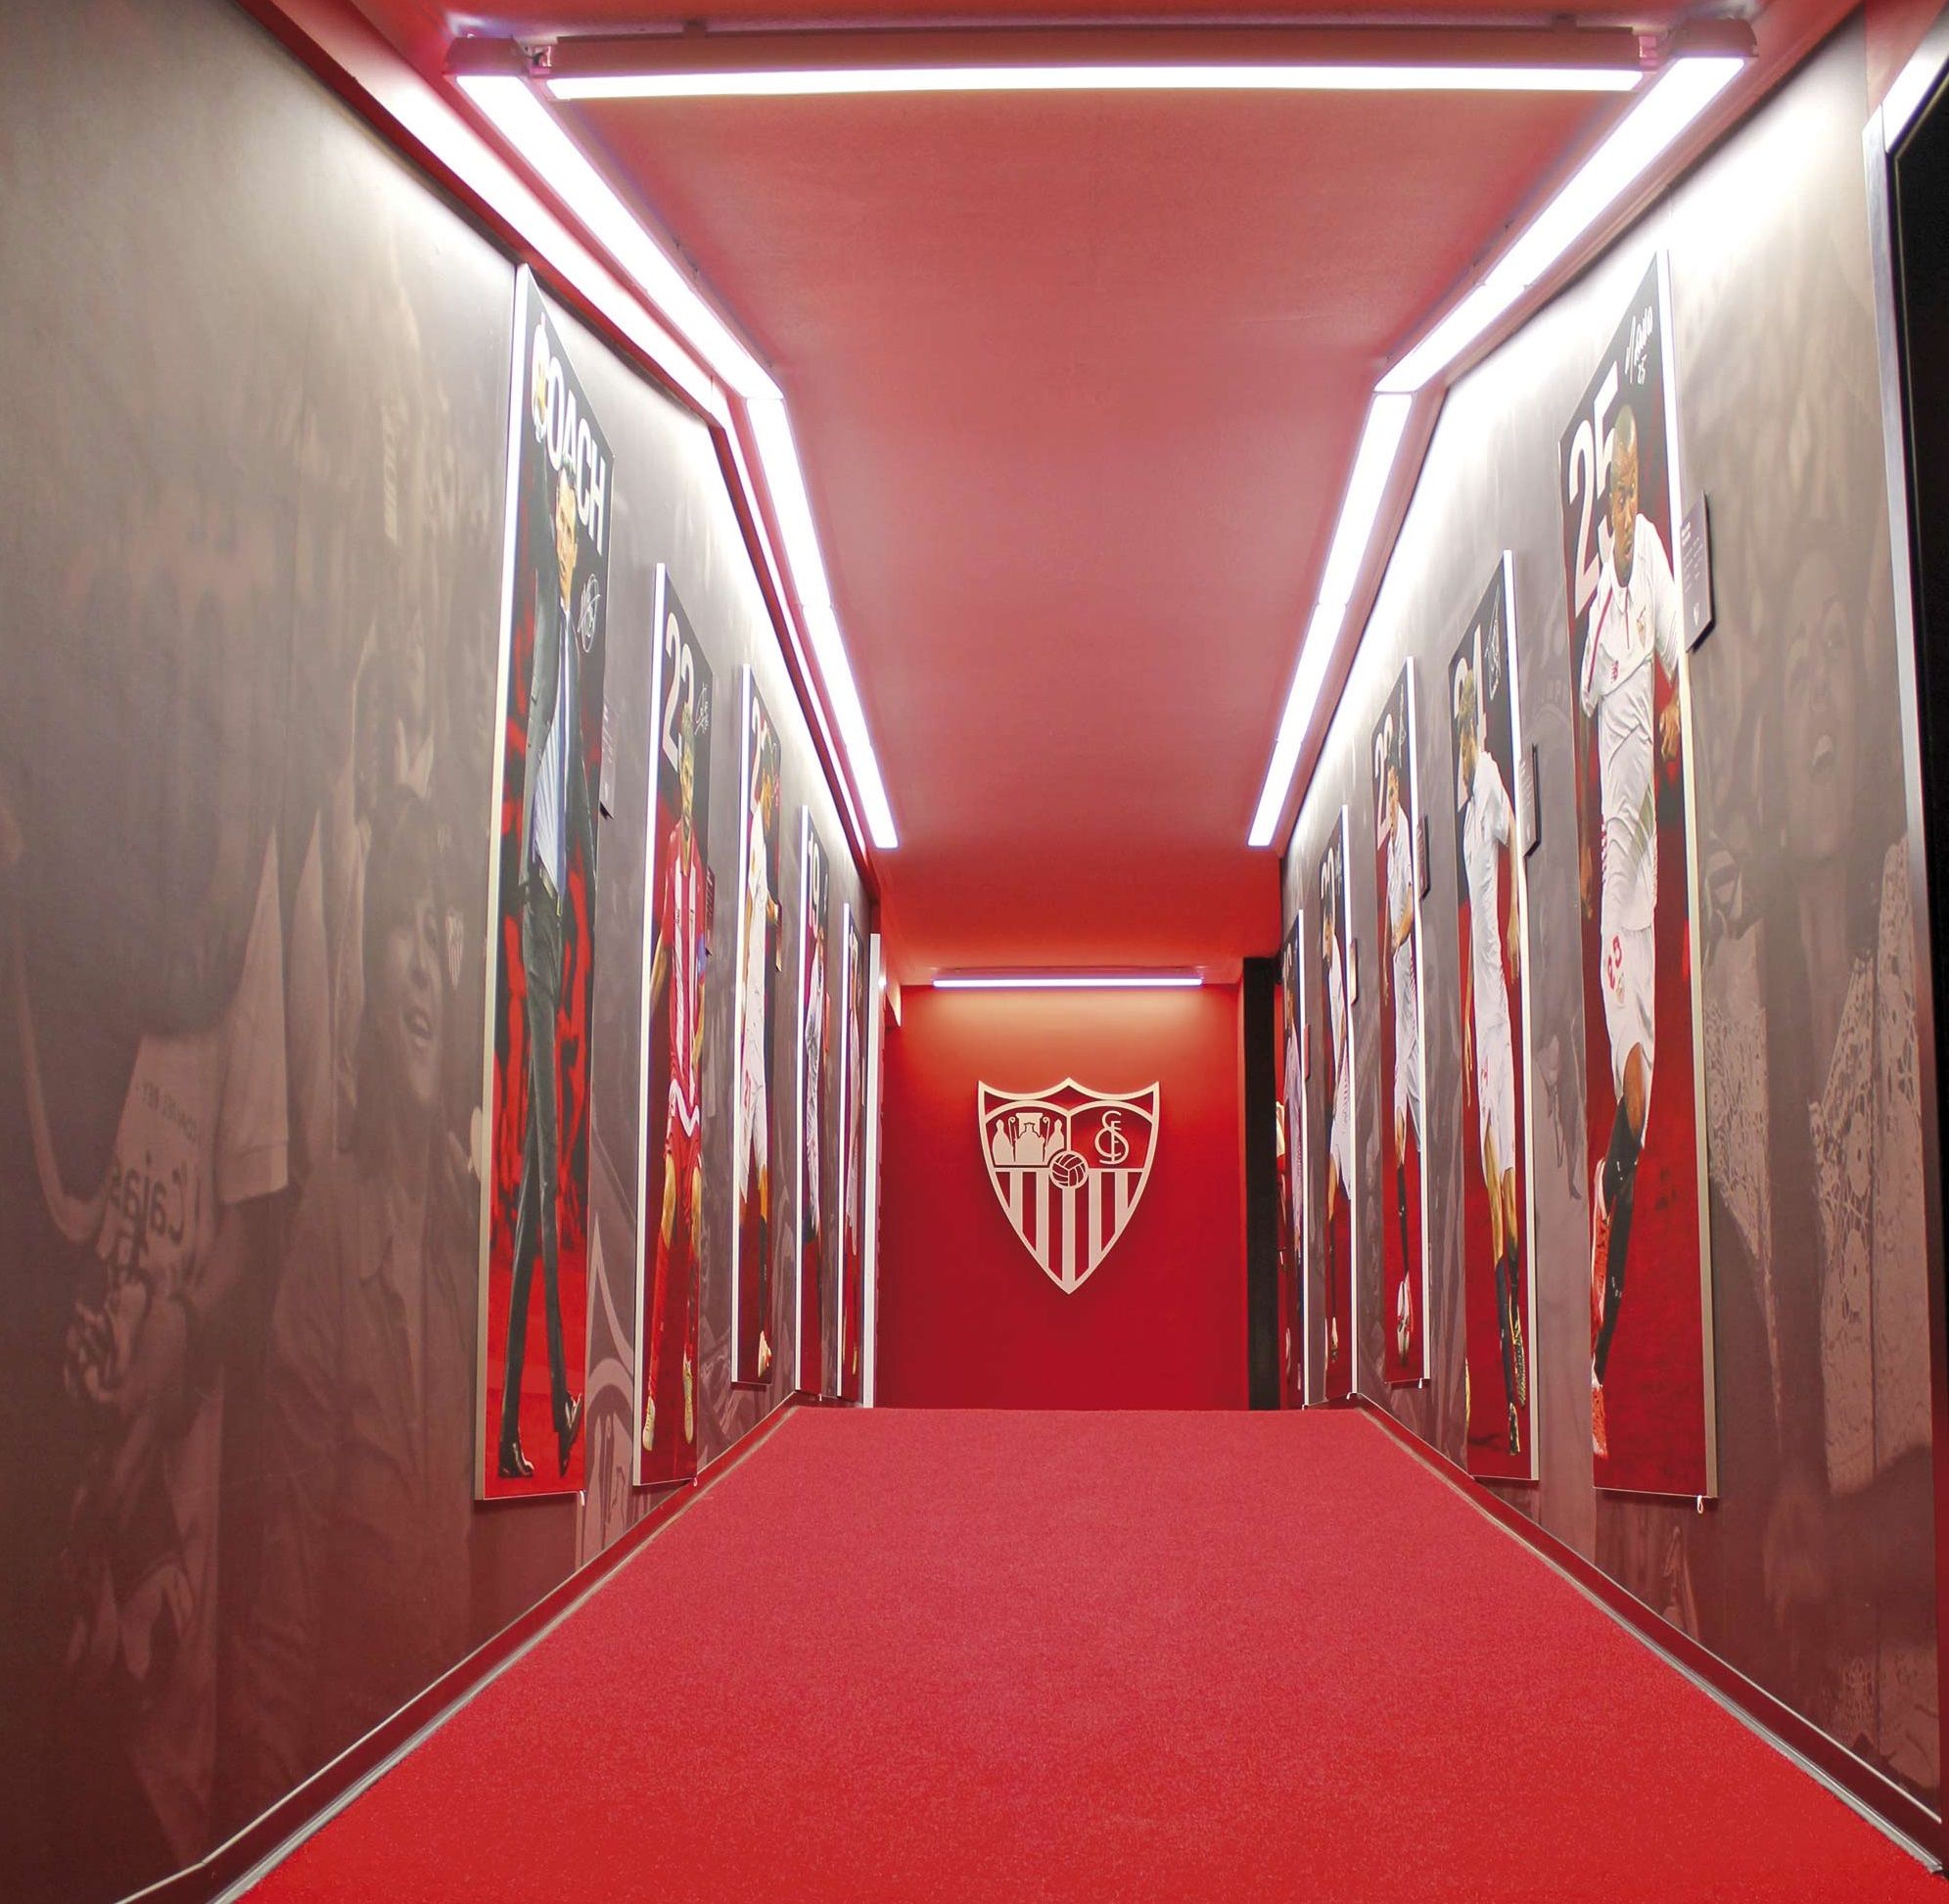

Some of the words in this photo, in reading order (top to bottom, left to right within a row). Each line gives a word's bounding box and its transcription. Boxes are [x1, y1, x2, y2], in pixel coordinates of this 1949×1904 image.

[532, 323, 606, 557] COACH
[1569, 360, 1619, 619] 25
[808, 831, 820, 939] 19
